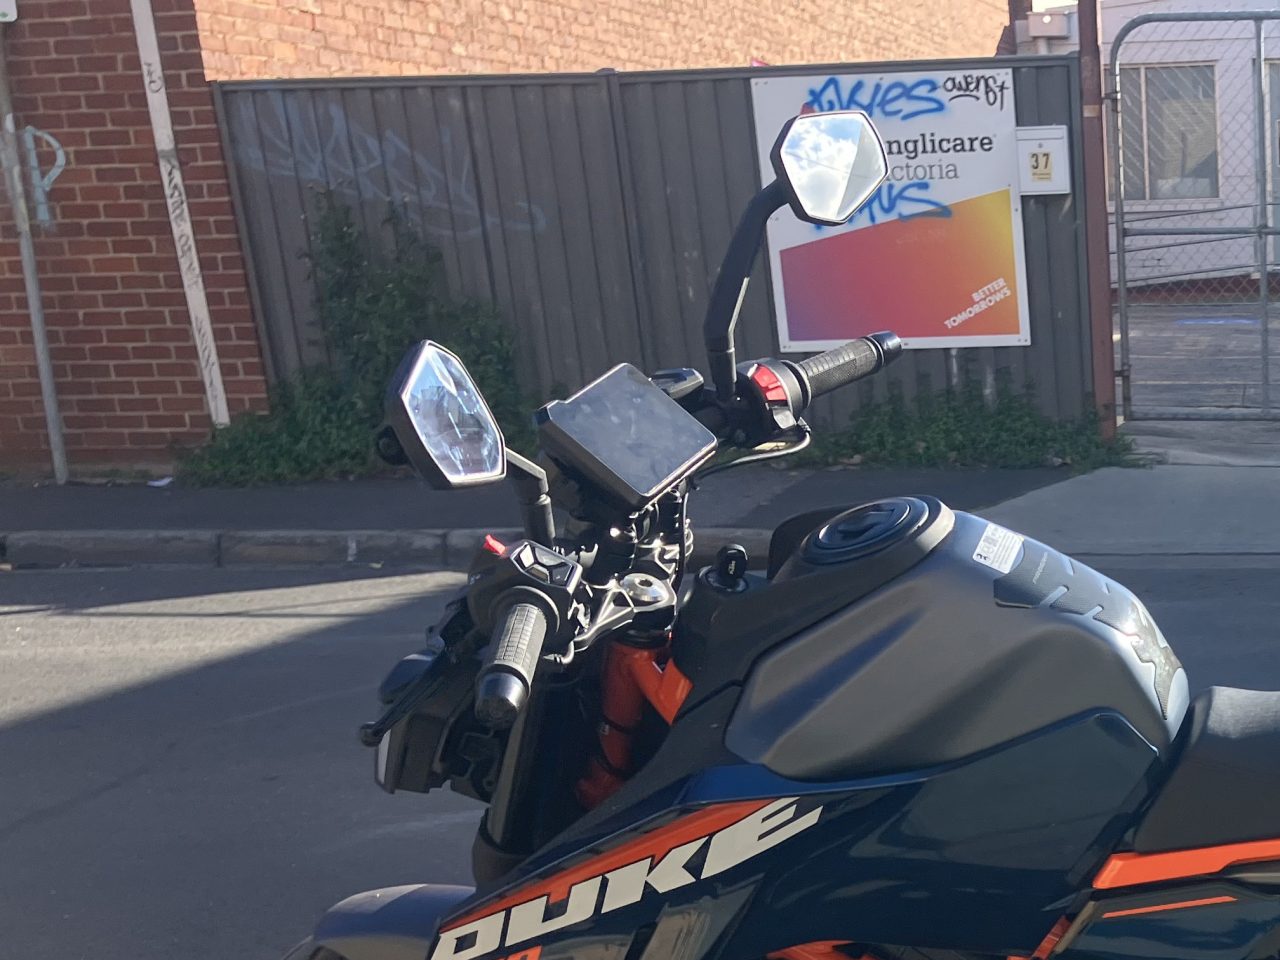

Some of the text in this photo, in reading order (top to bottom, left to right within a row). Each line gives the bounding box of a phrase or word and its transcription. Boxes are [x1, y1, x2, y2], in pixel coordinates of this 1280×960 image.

[886, 132, 994, 160] nglicare
[1031, 152, 1050, 170] 37
[971, 277, 1006, 302] BETTER
[944, 286, 1011, 329] TOMORROWS
